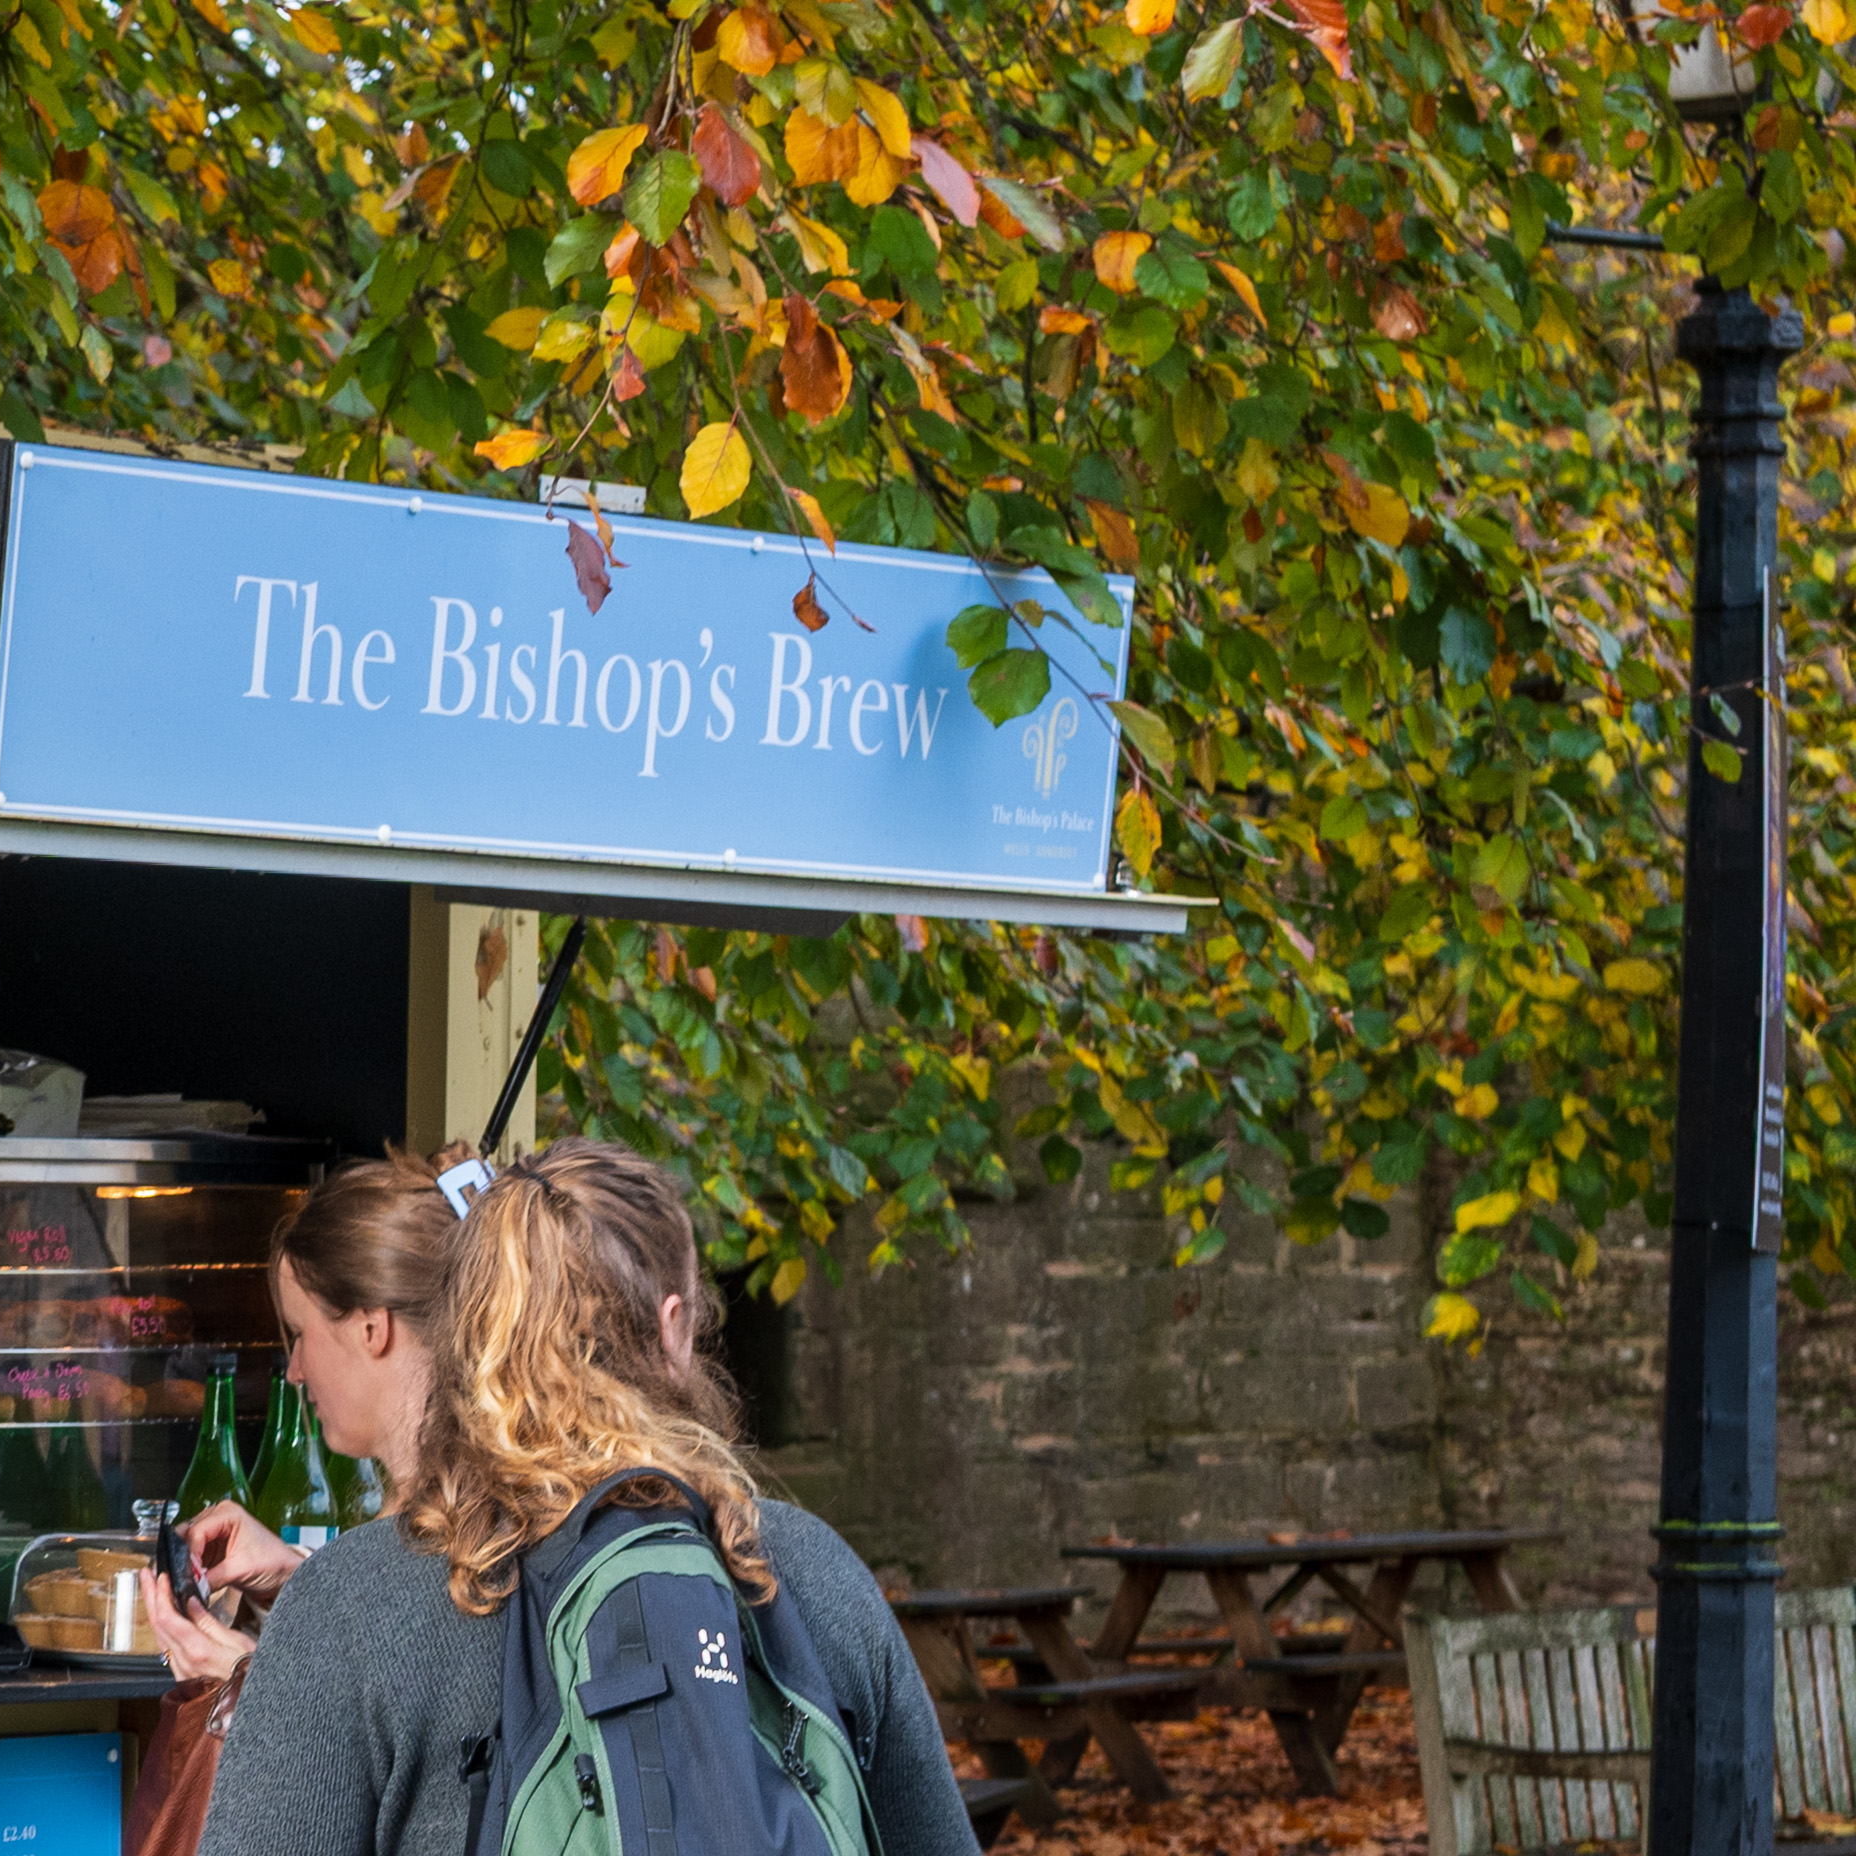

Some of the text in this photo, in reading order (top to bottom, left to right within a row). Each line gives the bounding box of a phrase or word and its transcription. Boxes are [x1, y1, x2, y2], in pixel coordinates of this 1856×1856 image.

[235, 575, 950, 778] The Bishop's Brew
[992, 804, 1095, 834] The Bishop's Palace
[2, 1824, 37, 1843] £2.40
